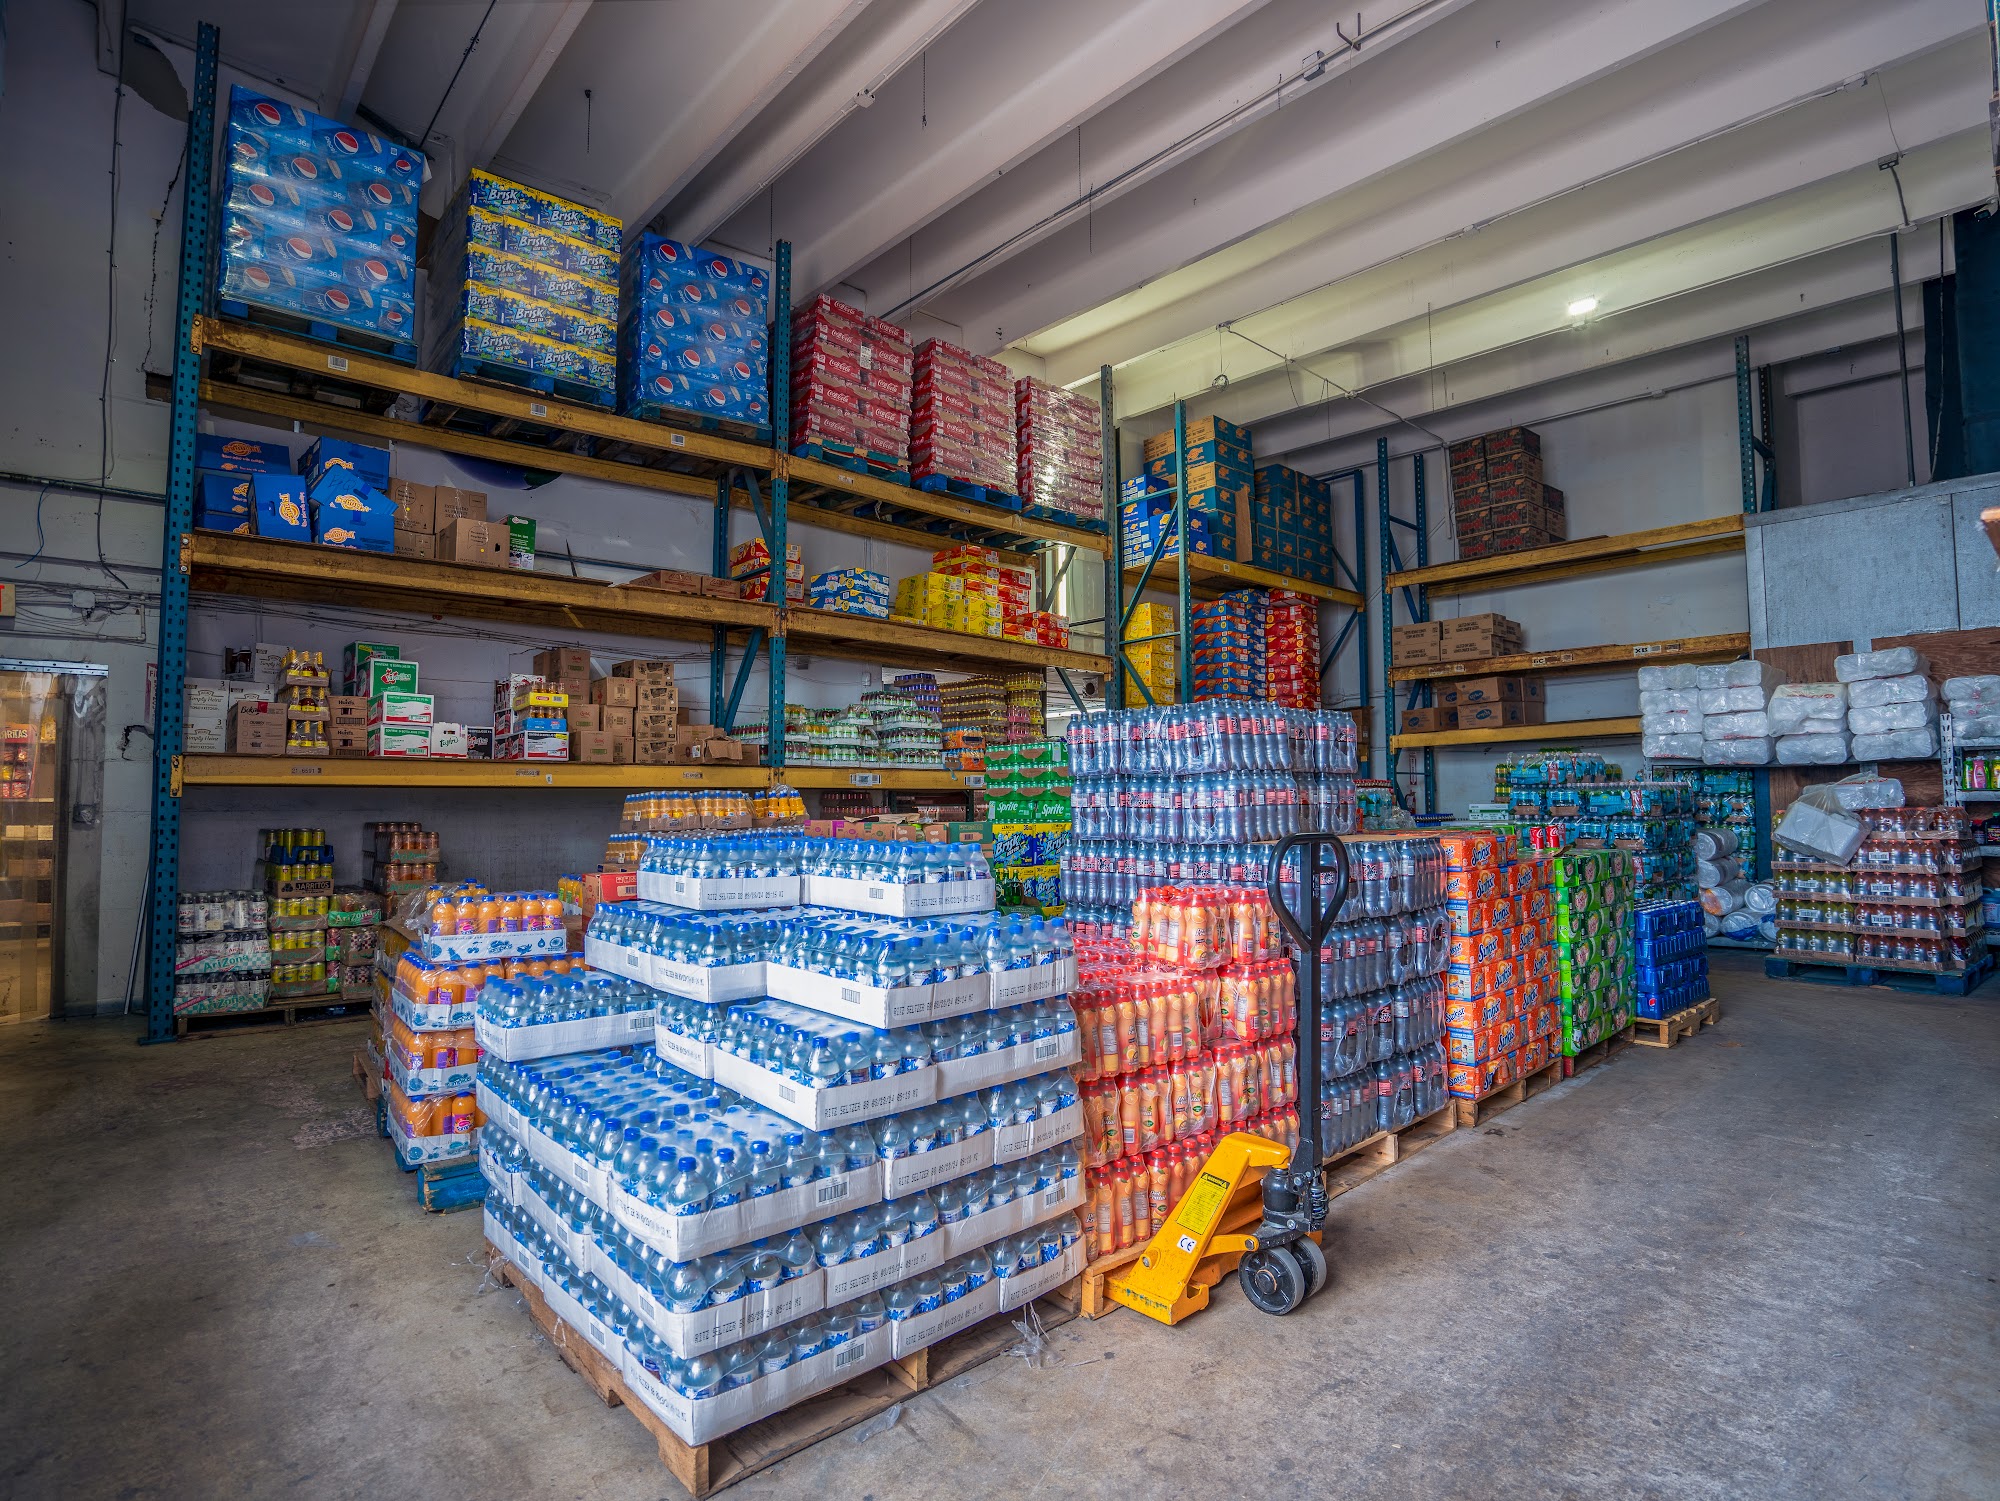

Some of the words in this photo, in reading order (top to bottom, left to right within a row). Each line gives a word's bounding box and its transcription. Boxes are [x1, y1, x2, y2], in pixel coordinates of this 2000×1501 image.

[488, 188, 519, 200] Brisk
[551, 210, 581, 222] Brisk
[474, 222, 498, 232] Brisk
[598, 226, 619, 235] Brisk
[520, 236, 551, 248] Brisk
[580, 255, 608, 266] Brisk
[485, 261, 517, 273] Brisk
[548, 280, 578, 292] Brisk
[470, 296, 495, 306] Brisk
[595, 294, 615, 304] Brisk
[516, 307, 547, 320] Brisk
[577, 324, 605, 336] Brisk
[481, 335, 512, 348] Brisk
[545, 352, 575, 364] Brisk
[997, 801, 1018, 812] Sprite
[1042, 803, 1064, 816] Sprite
[995, 834, 1020, 853] Brisk
[297, 881, 330, 892] JARRITOS
[1038, 878, 1054, 894] Brisk
[335, 909, 375, 924] AriZona
[204, 955, 249, 972] AriZona
